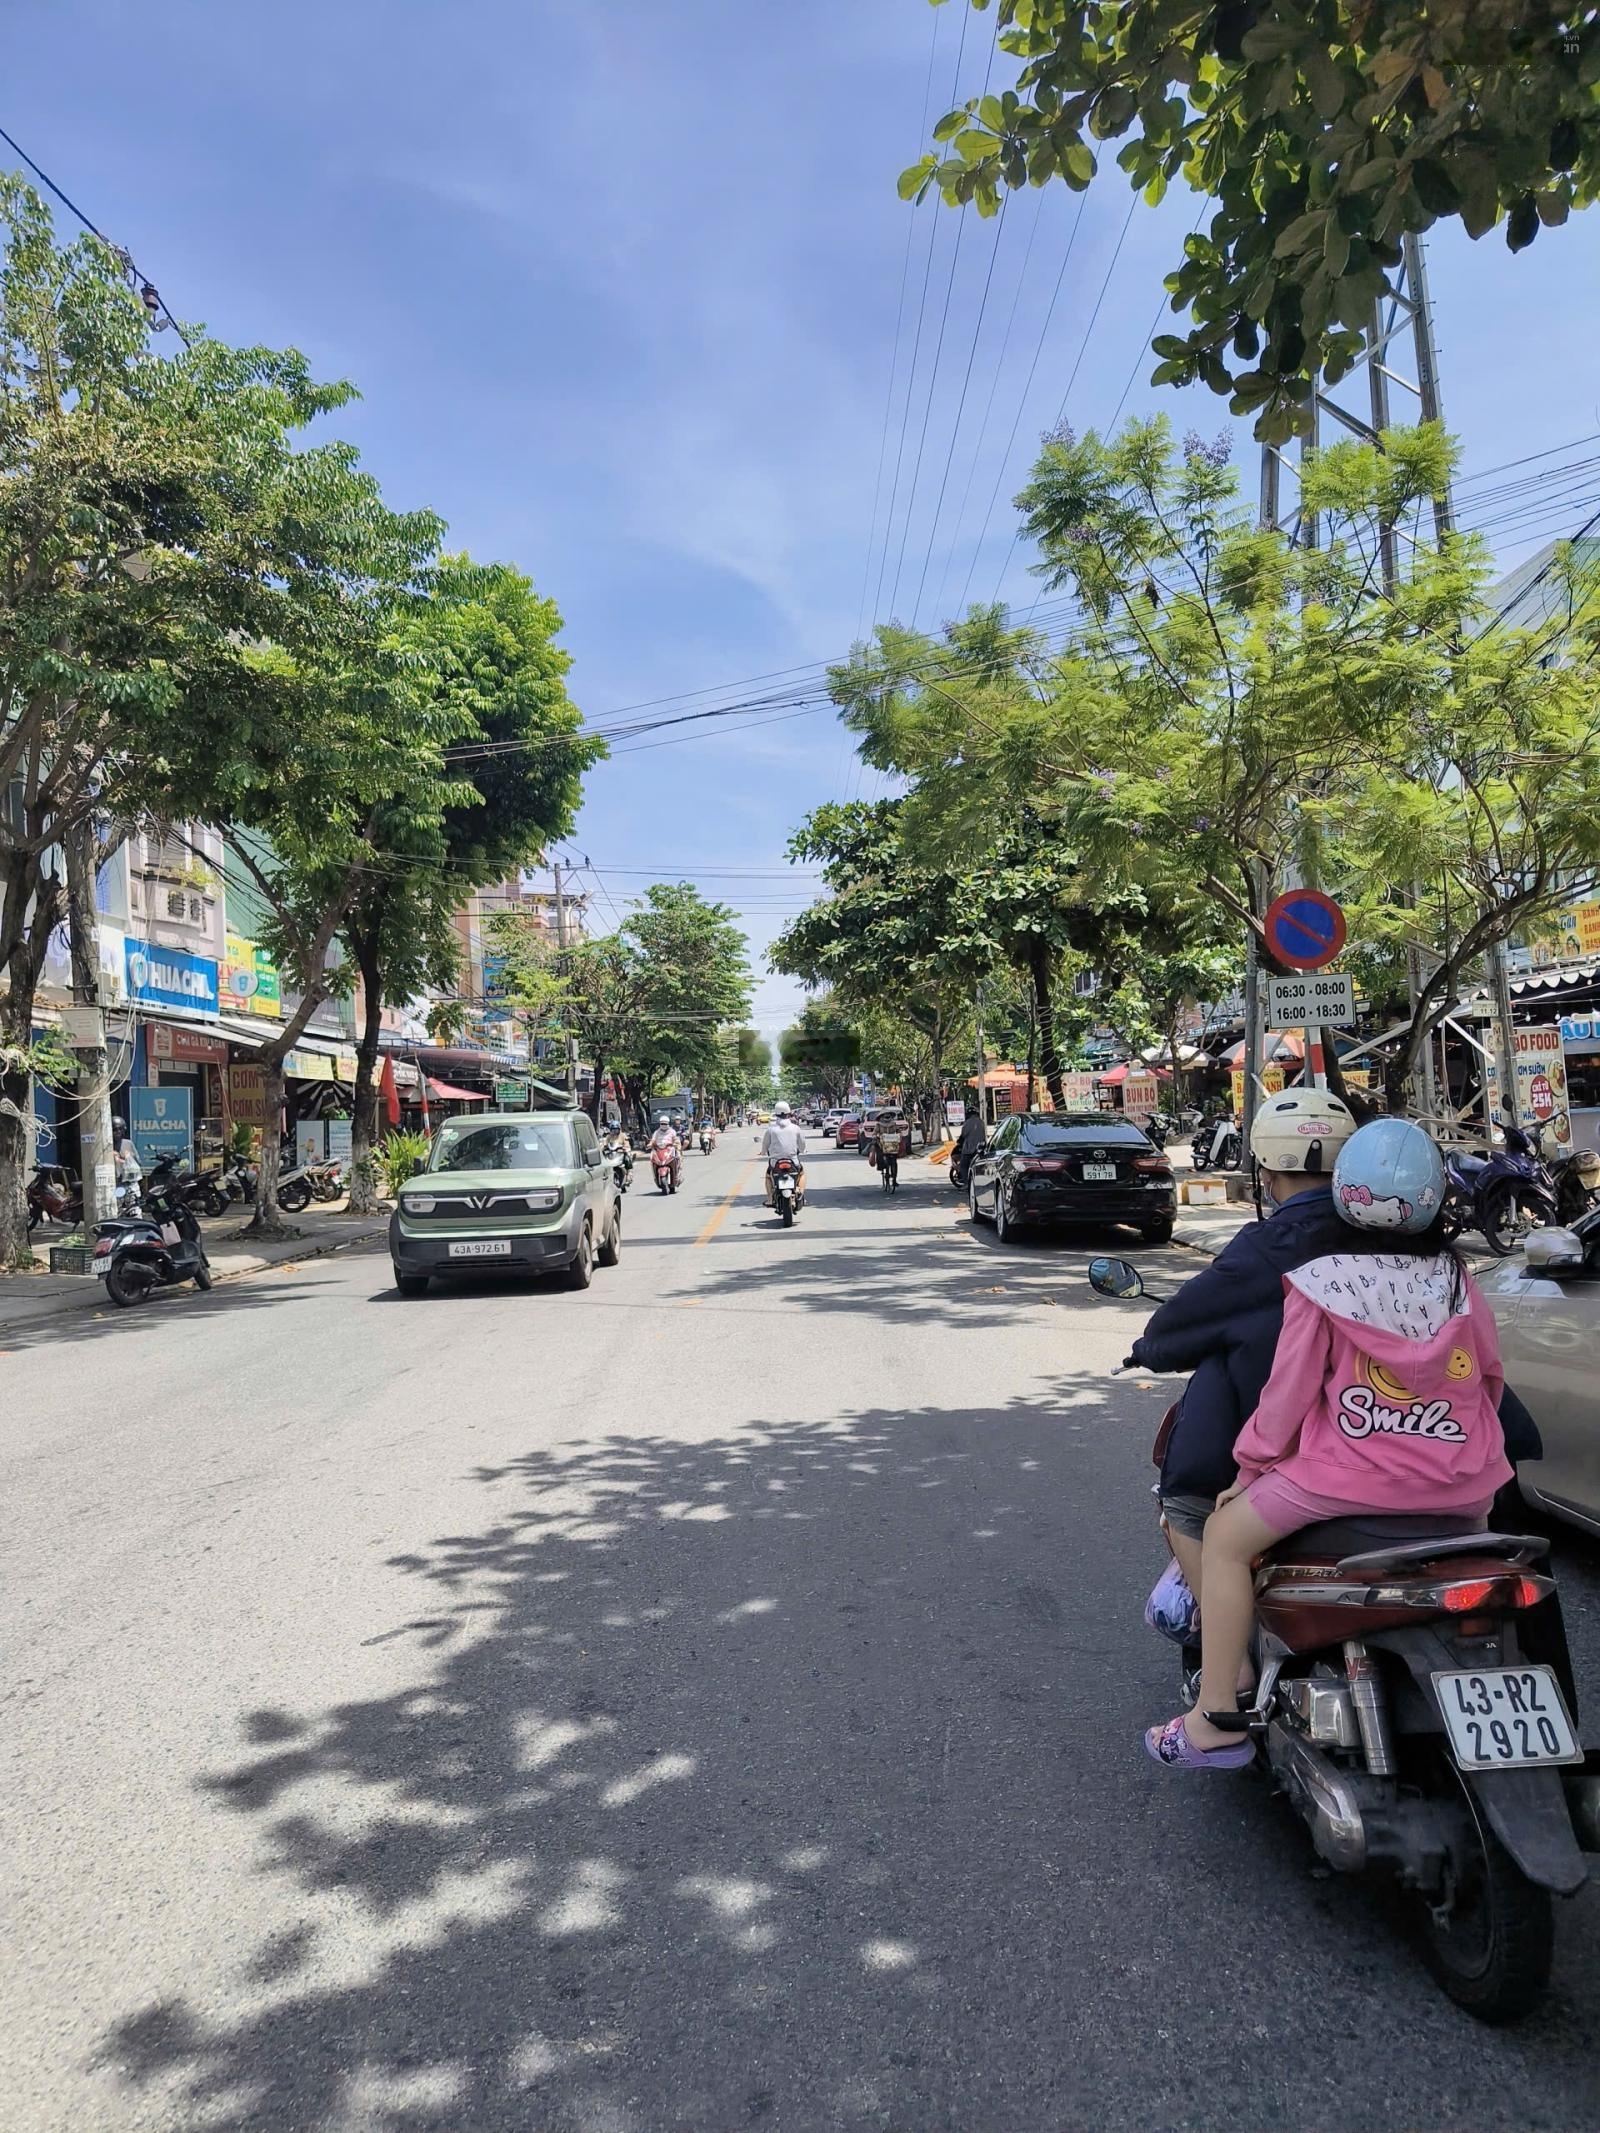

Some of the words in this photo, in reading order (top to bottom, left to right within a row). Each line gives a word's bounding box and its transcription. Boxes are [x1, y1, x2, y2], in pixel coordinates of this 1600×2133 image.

[1275, 984, 1306, 998] 06:30
[1315, 981, 1345, 996] 08:00
[1276, 1006, 1306, 1020] 16:00
[1316, 1003, 1346, 1018] 18:30
[1530, 1033, 1559, 1051] FOOD
[1338, 1384, 1469, 1443] Smile
[1454, 1673, 1547, 1716] 43-R2
[1466, 1716, 1561, 1761] 2920
